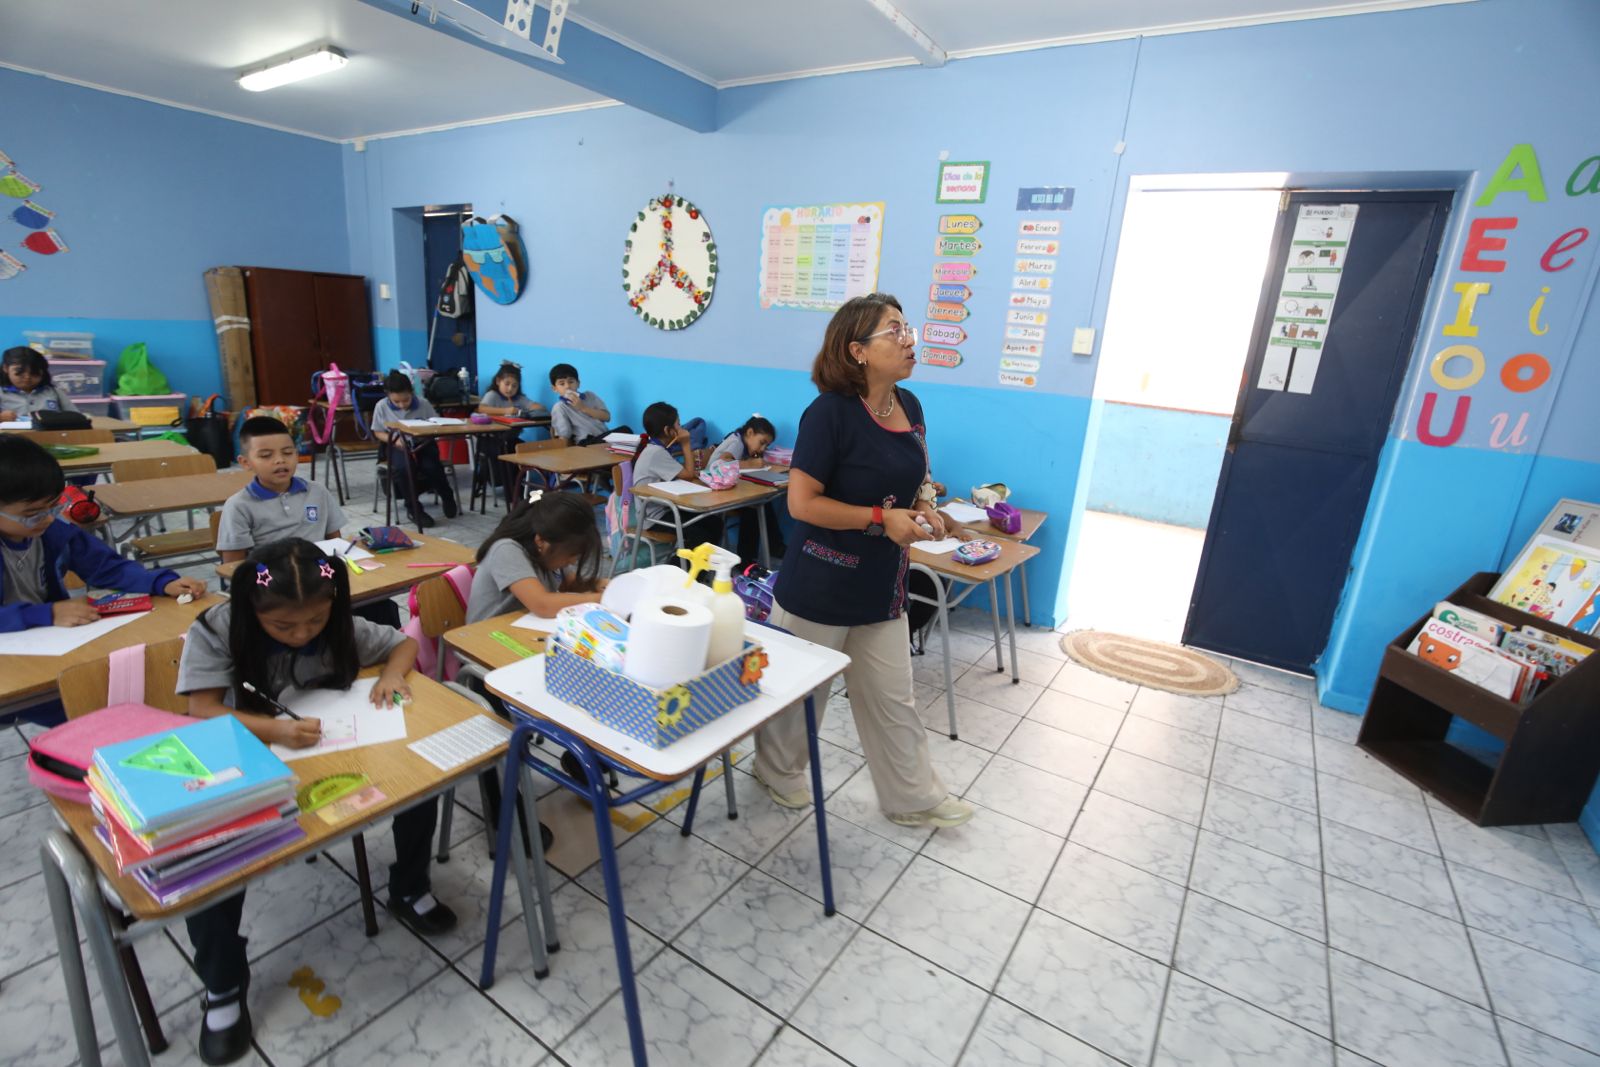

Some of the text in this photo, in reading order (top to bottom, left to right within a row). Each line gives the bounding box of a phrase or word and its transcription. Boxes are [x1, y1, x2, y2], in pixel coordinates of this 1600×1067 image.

[963, 172, 973, 181] de
[1473, 143, 1548, 206] A
[946, 185, 977, 193] semana
[797, 206, 843, 217] HORARIO
[946, 220, 975, 229] Lunes
[1035, 223, 1057, 232] Enero
[939, 240, 977, 251] Martes
[1020, 243, 1047, 251] Febrero
[1459, 217, 1589, 272] E e
[1028, 261, 1053, 271] Marzo
[1018, 279, 1037, 287] Abril
[933, 287, 966, 297] Jueves
[1026, 297, 1048, 306] Mayo
[929, 305, 964, 317] Viernes
[1442, 282, 1551, 337] I i
[1014, 312, 1034, 321] Junio
[1023, 329, 1040, 337] Julio
[1006, 344, 1029, 352] Agosto
[922, 350, 958, 362] Domingo
[1430, 345, 1552, 393] O o
[1000, 374, 1024, 382] Octubre
[1416, 392, 1530, 448] U u
